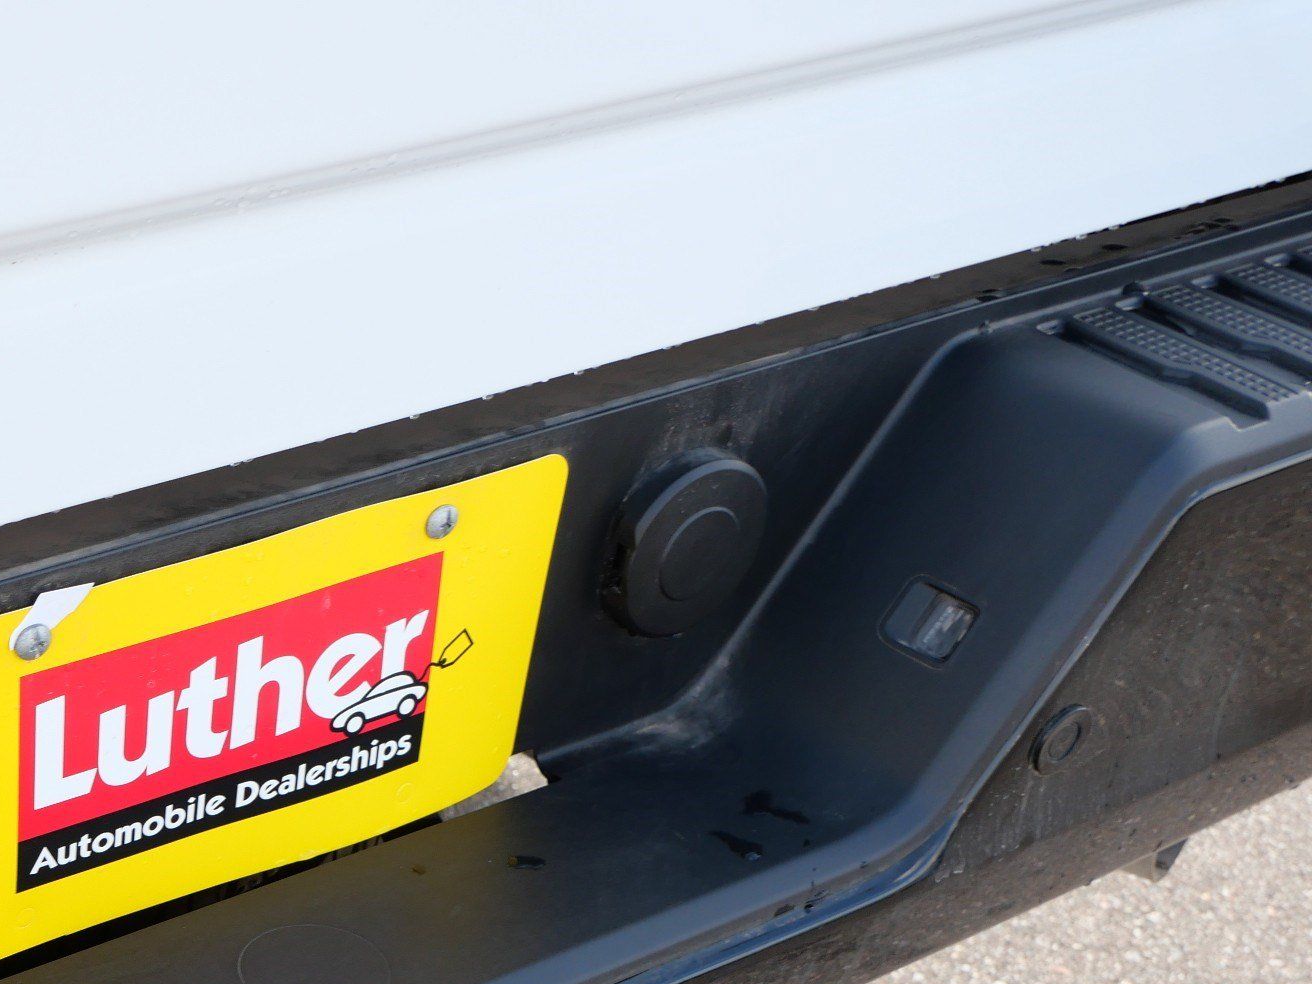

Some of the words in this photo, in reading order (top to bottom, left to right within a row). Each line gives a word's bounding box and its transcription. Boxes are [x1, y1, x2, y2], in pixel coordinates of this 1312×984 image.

[33, 609, 429, 811] Luther
[29, 793, 227, 875] Automobile
[234, 734, 412, 808] Dealerships
